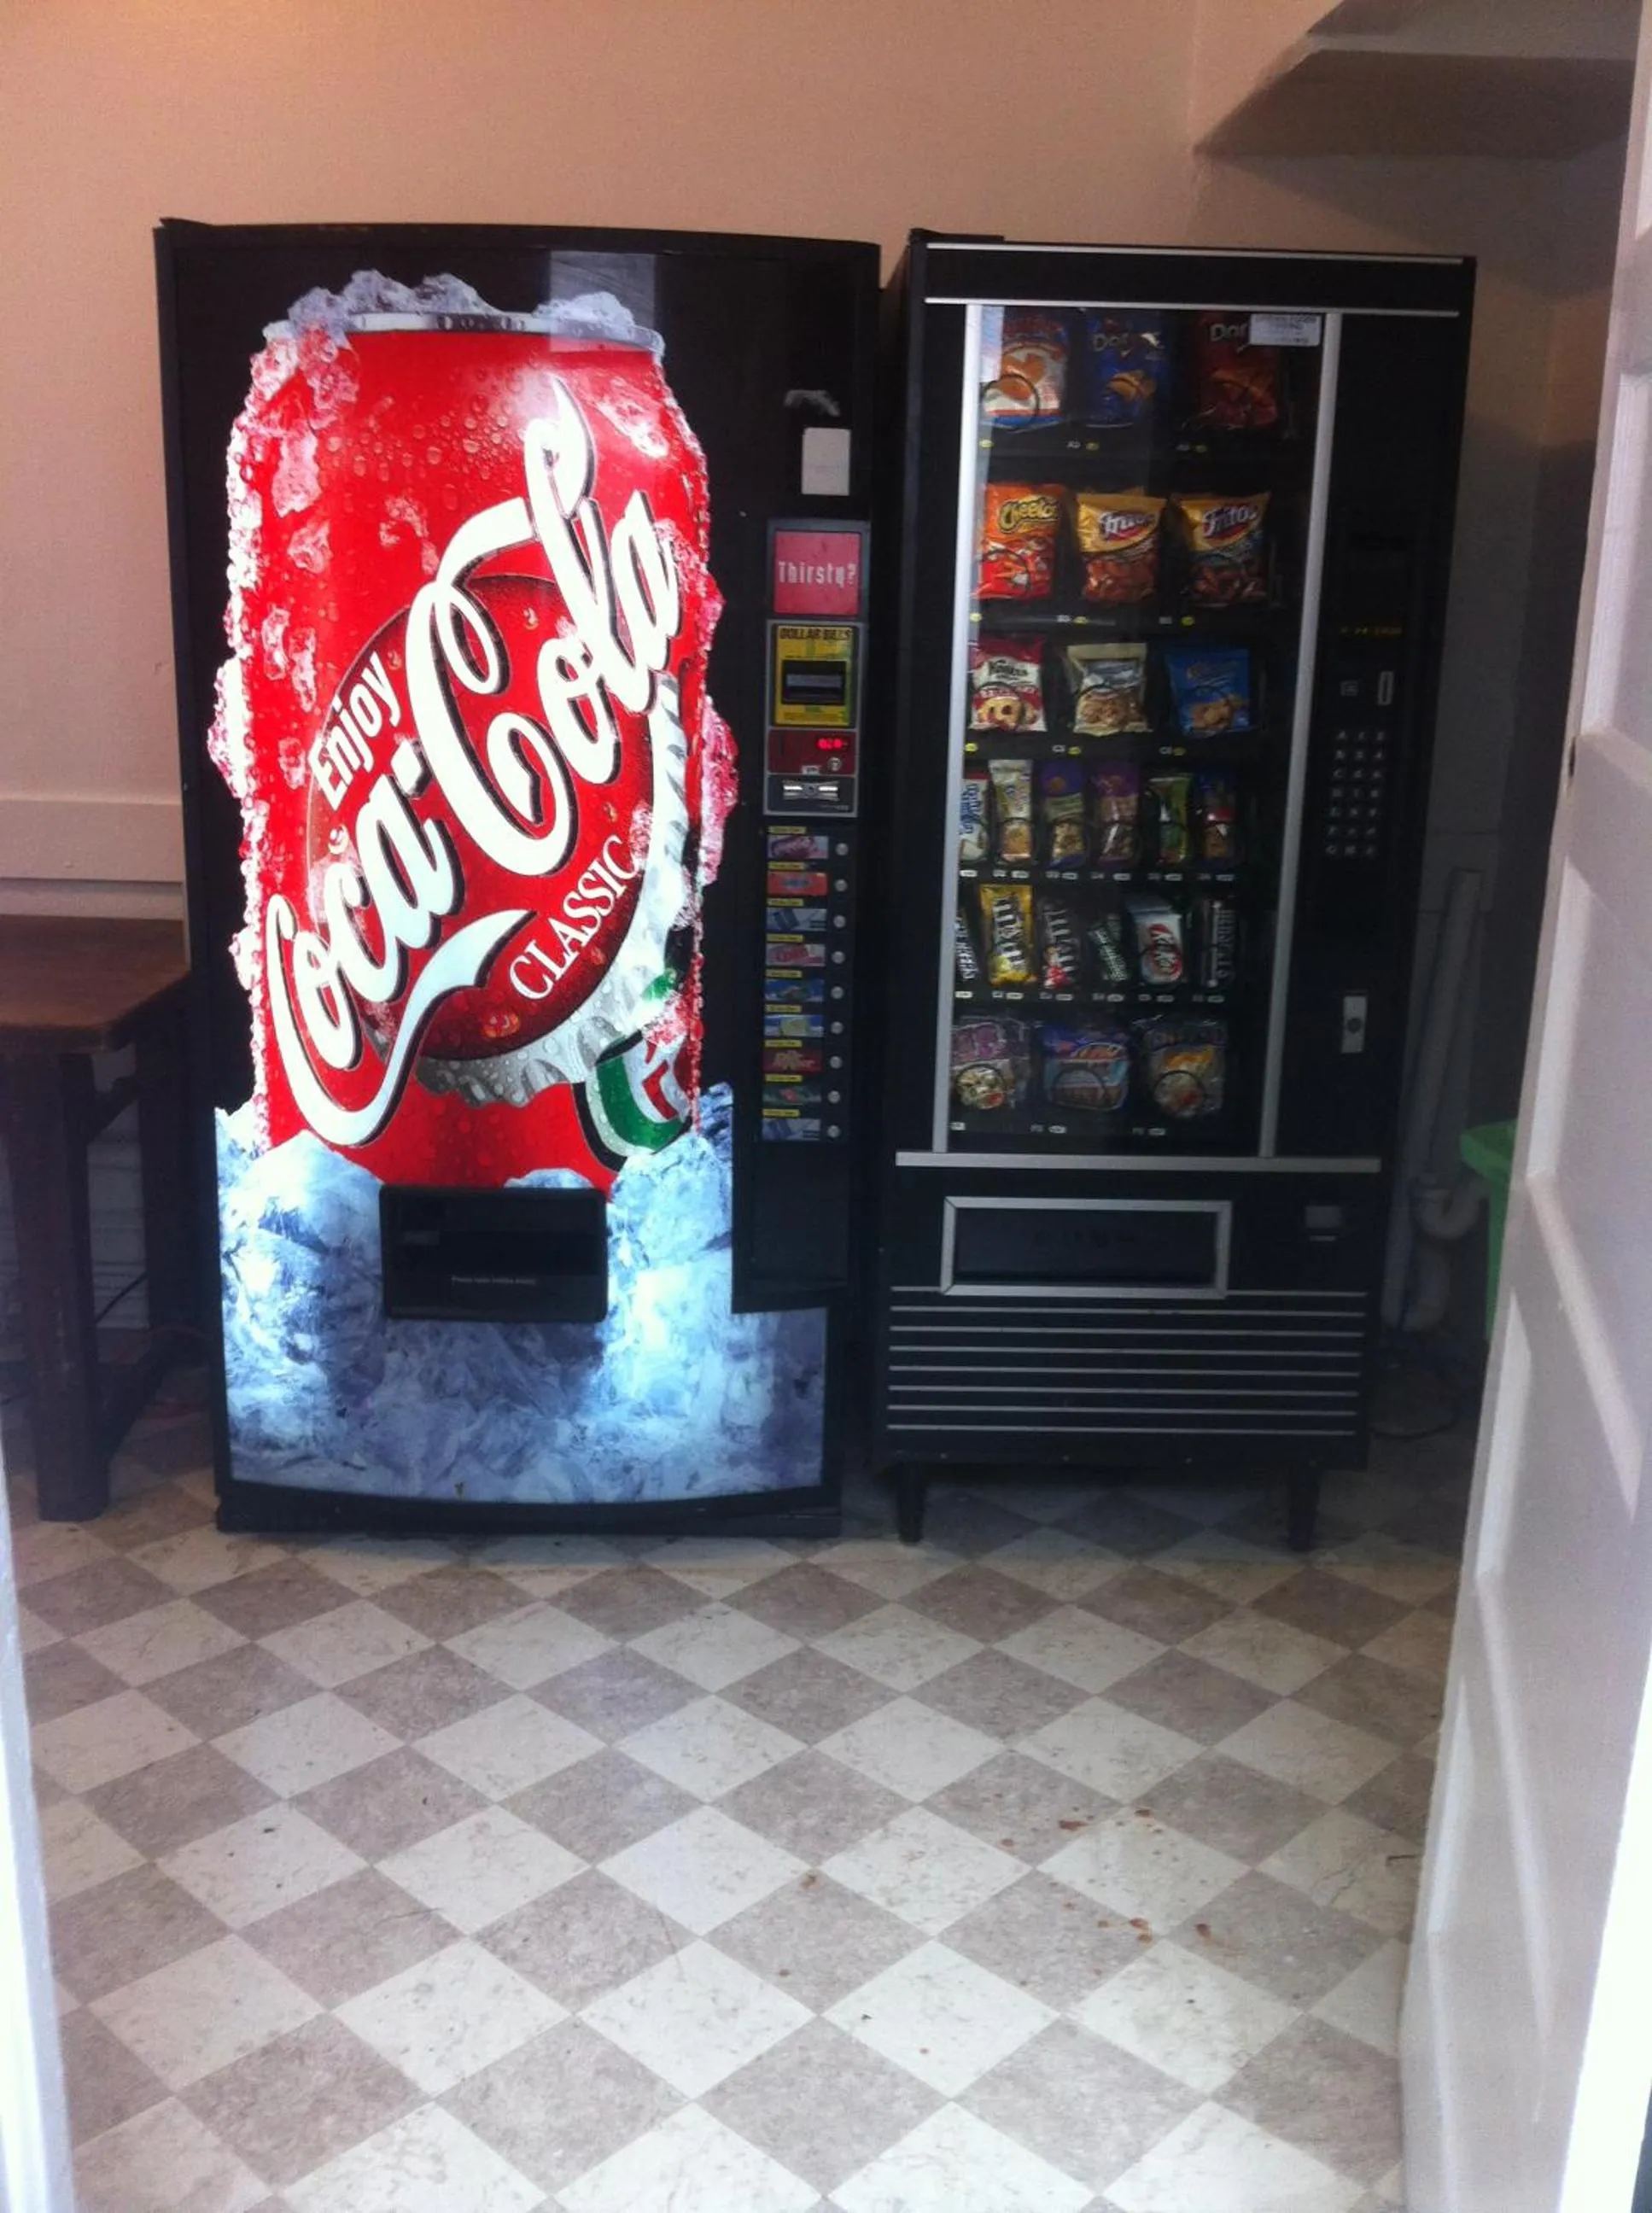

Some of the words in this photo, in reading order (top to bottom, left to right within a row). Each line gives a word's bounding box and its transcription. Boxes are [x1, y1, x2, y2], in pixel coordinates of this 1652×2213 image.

[778, 561, 857, 588] Thirsty?
[266, 374, 682, 1147] Coca-Cola
[308, 650, 401, 809] Enjoy
[509, 835, 637, 1004] CLASSIC
